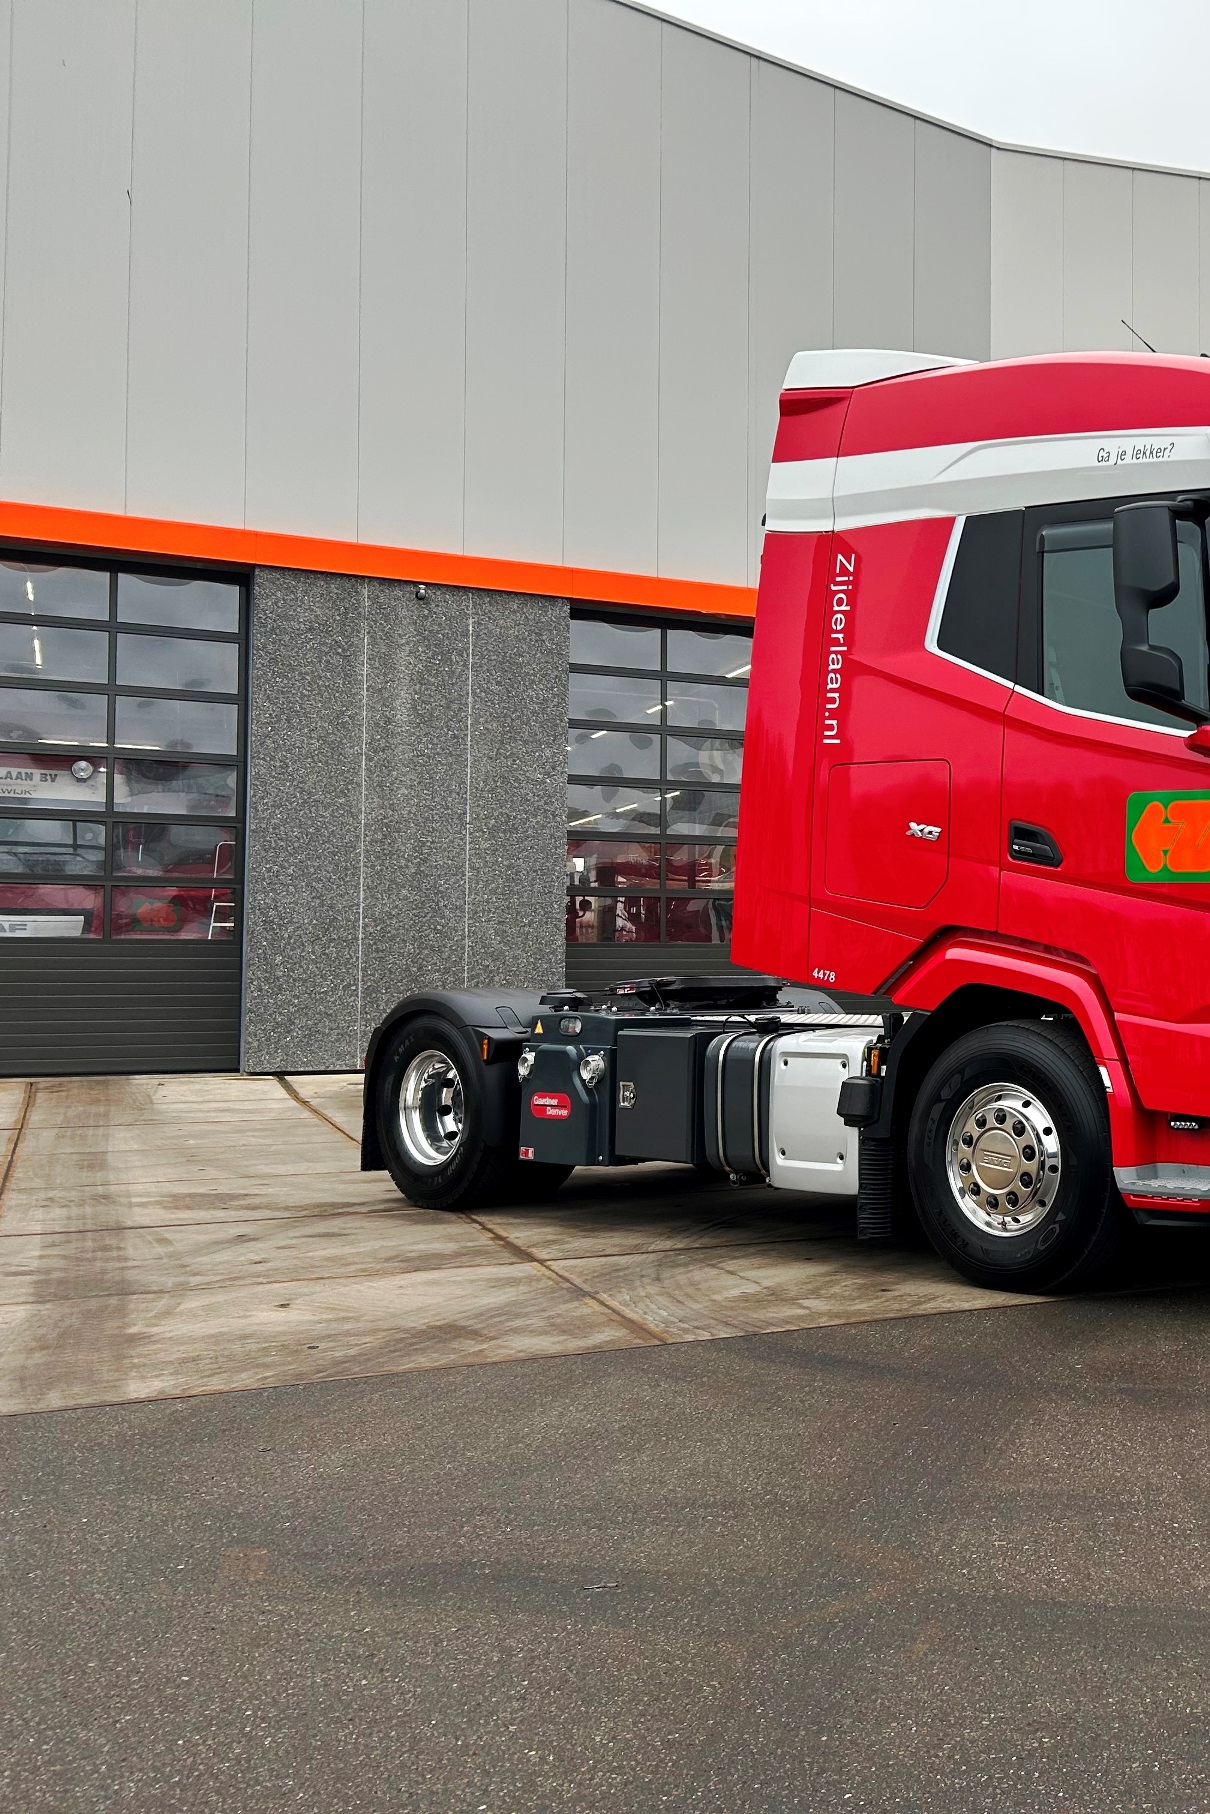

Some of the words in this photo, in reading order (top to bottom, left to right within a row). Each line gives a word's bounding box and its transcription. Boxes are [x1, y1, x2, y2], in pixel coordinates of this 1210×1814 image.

[1097, 447, 1111, 463] Ga
[1113, 446, 1127, 466] je
[1131, 442, 1175, 460] lekker?
[822, 553, 856, 744] Zijderlaan.nl
[40, 773, 58, 782] BV
[906, 821, 942, 841] XG
[812, 967, 836, 983] 4478
[533, 1096, 559, 1105] Gardner
[546, 1107, 568, 1116] Denver
